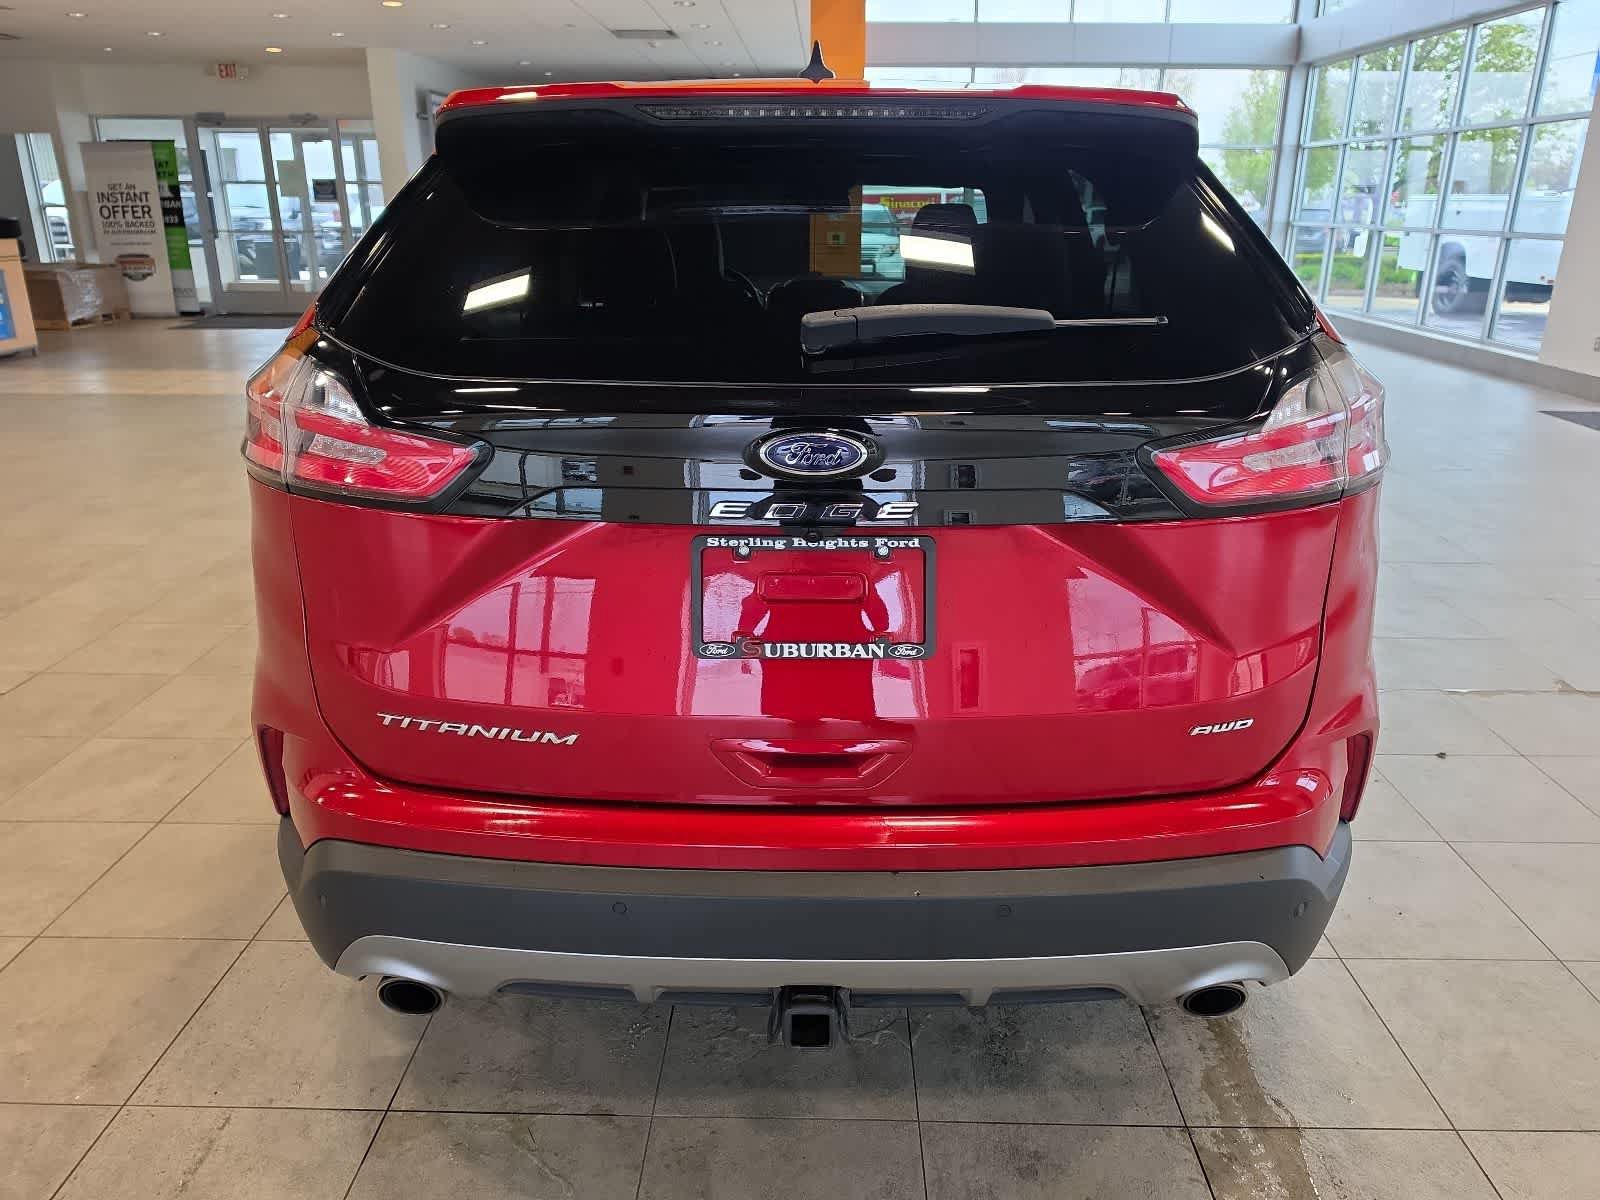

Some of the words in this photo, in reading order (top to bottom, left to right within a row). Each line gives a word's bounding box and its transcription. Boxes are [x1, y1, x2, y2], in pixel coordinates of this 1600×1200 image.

[96, 191, 150, 203] INSTANT
[99, 205, 153, 220] OFFER
[784, 441, 843, 467] Ford
[708, 501, 919, 520] EDGE
[706, 537, 787, 549] Sterling
[874, 537, 920, 549] Ford
[743, 641, 885, 658] SUBURBAN
[376, 711, 581, 746] TITANIUM
[1188, 718, 1255, 736] AWD
